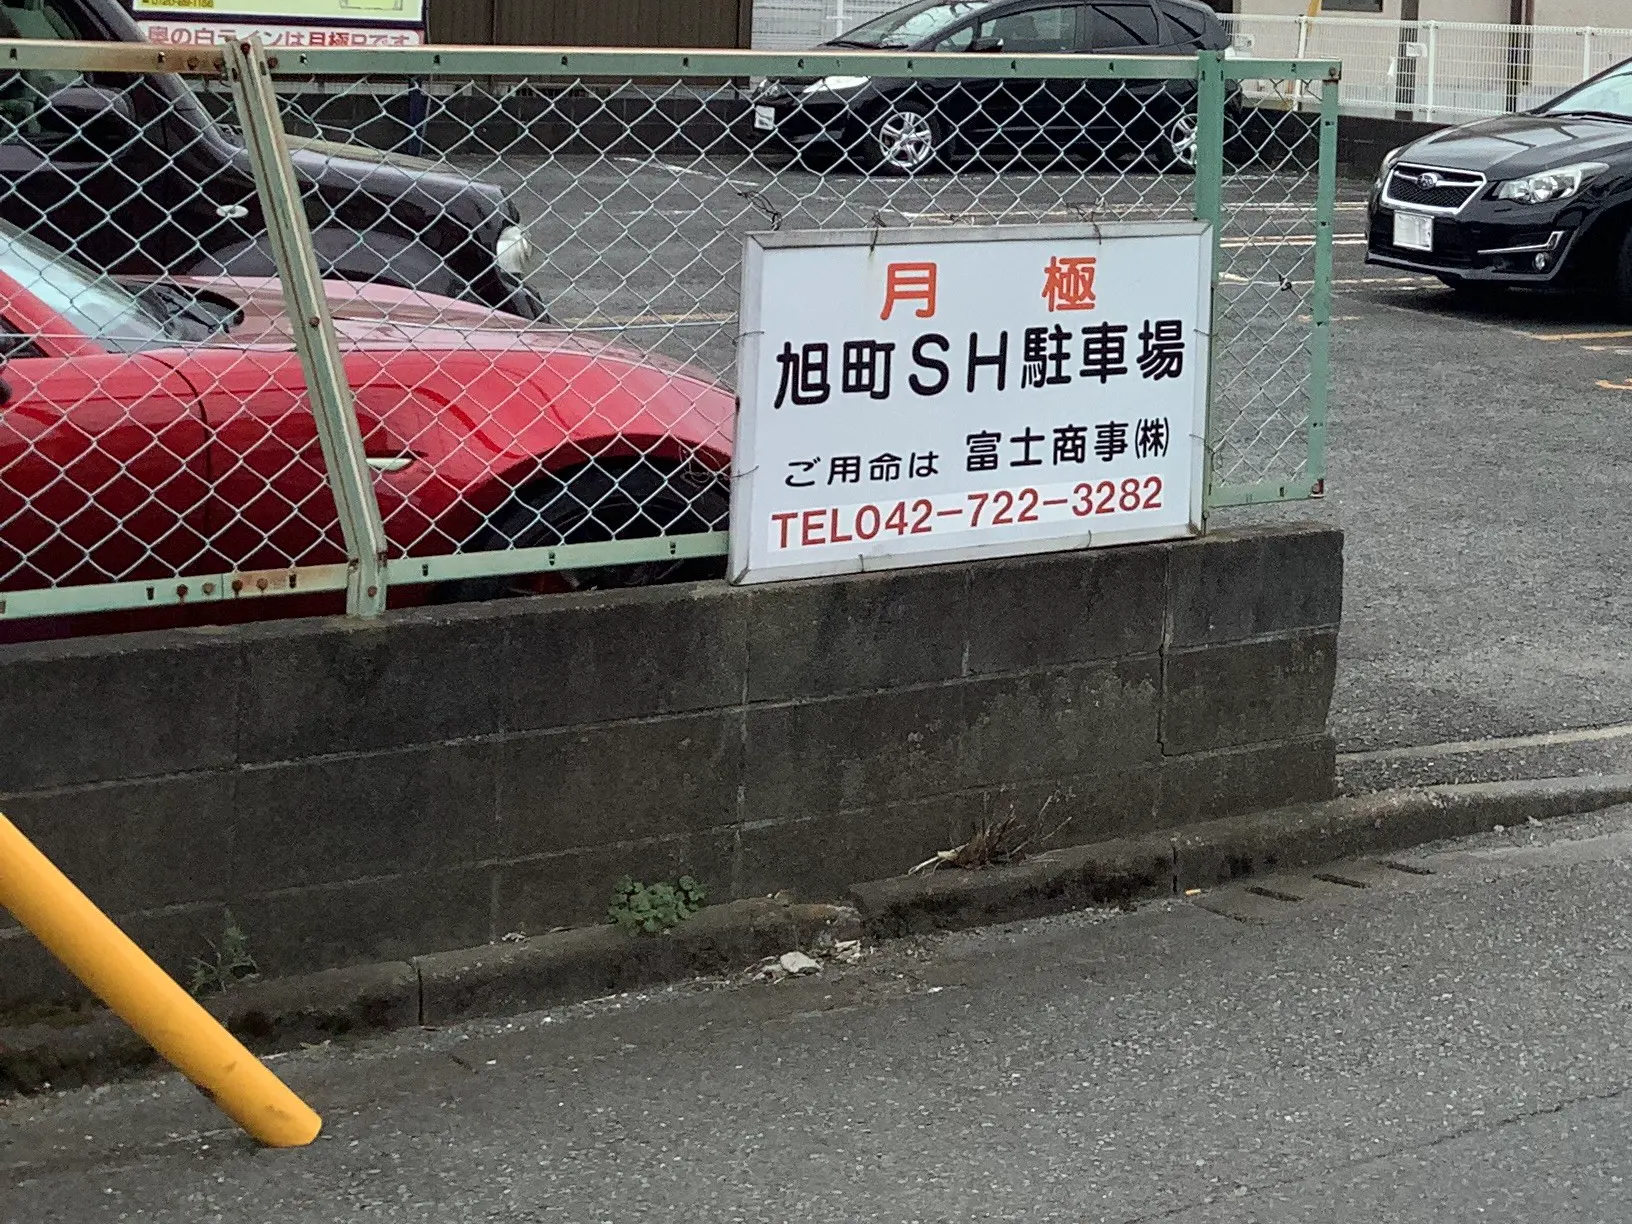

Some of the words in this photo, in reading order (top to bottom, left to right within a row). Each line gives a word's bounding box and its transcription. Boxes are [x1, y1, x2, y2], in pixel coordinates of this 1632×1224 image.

[773, 319, 1185, 410] 旭町SH駐車場
[784, 451, 940, 488] ご用命は
[771, 476, 1163, 549] TEL042-722-3282
